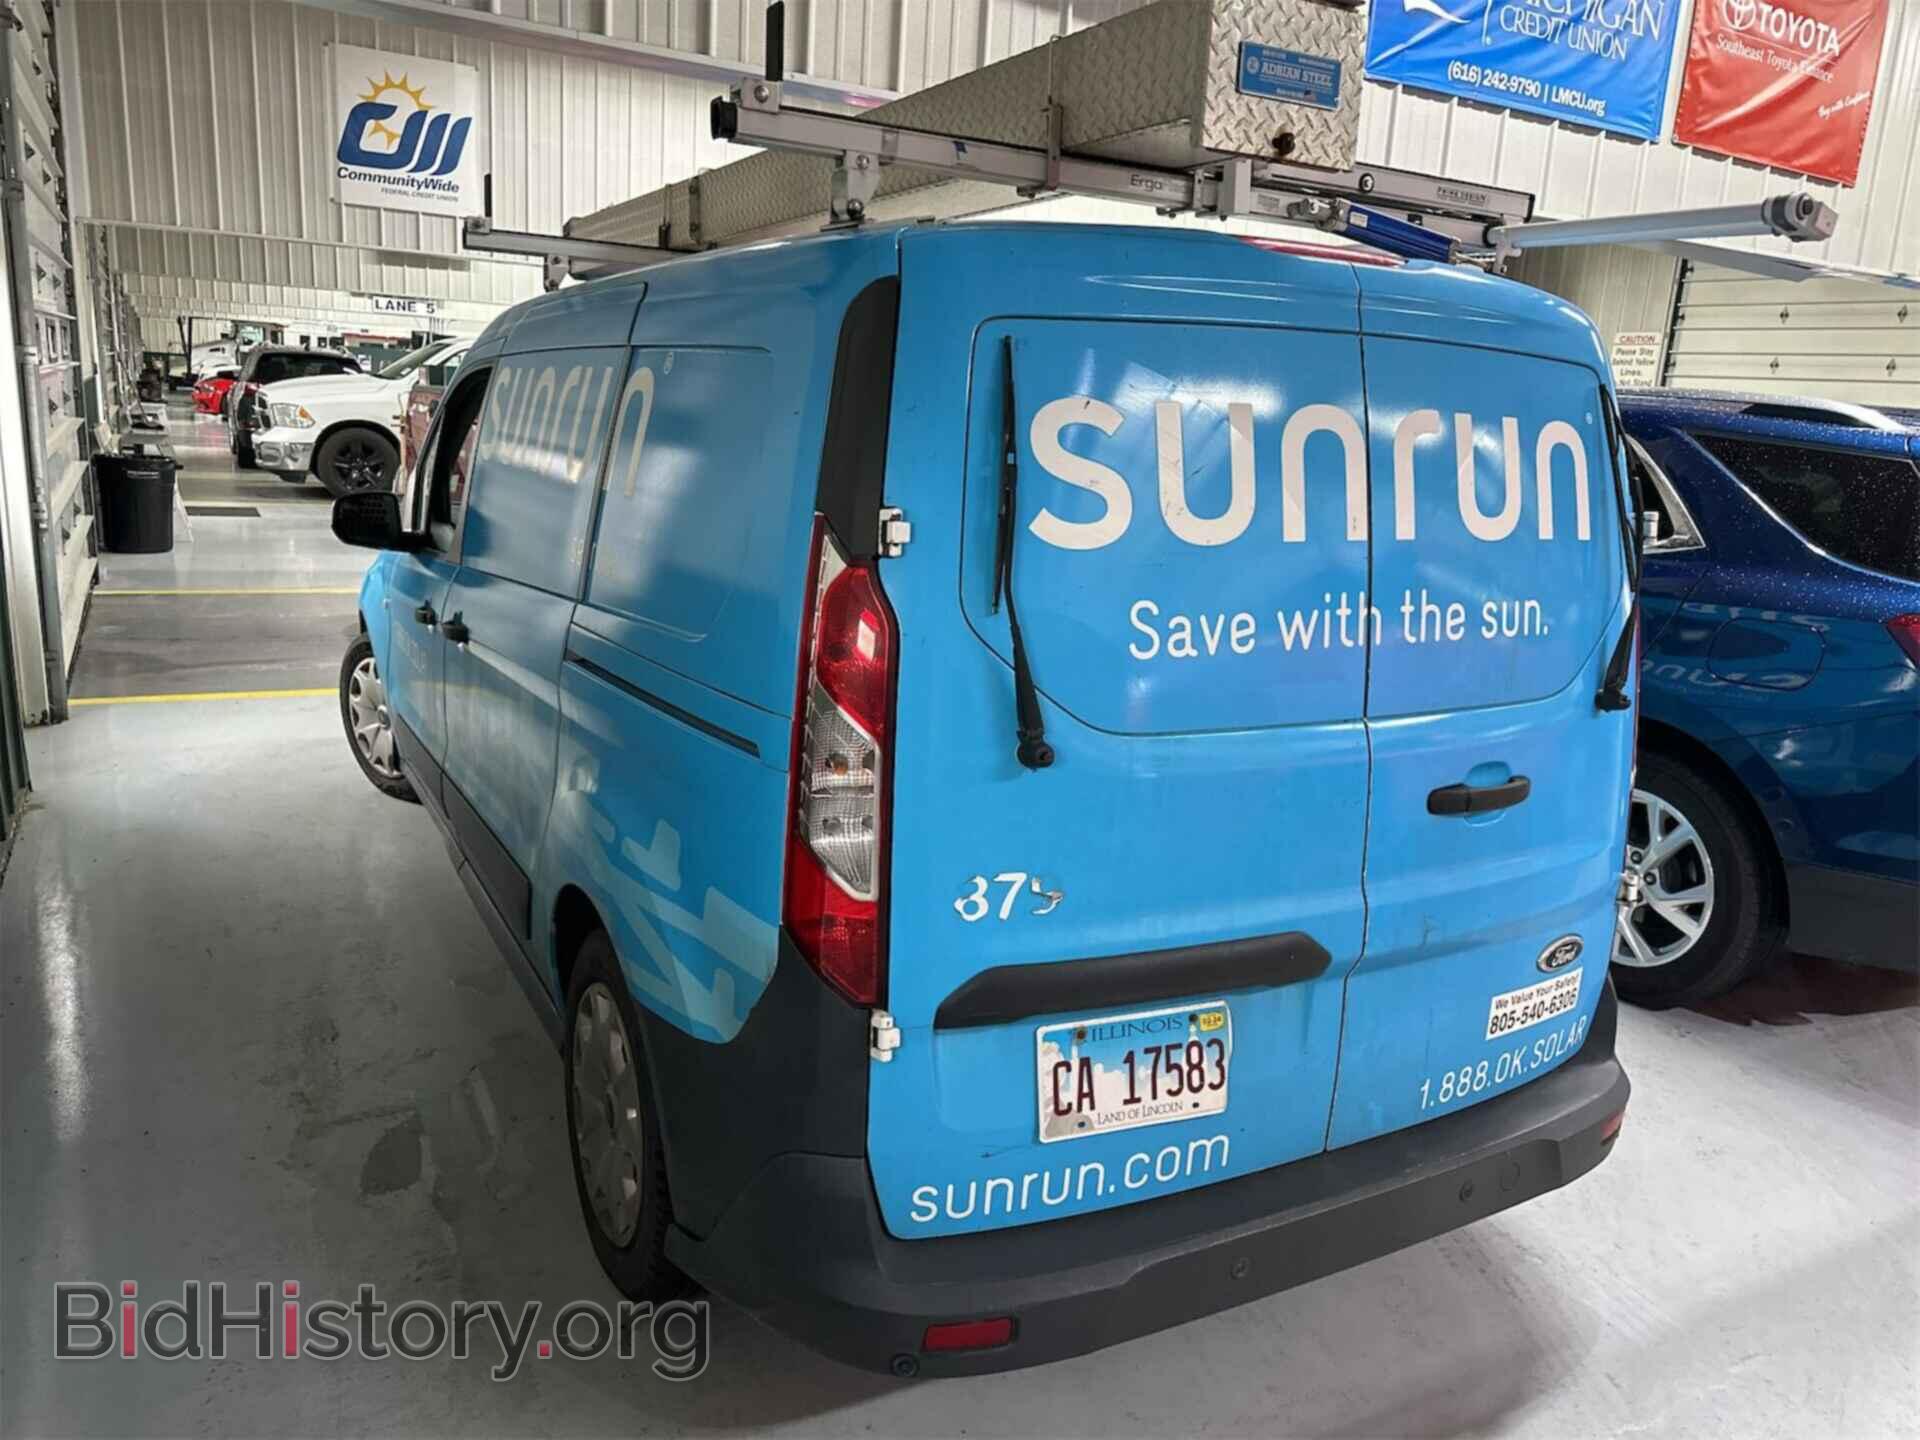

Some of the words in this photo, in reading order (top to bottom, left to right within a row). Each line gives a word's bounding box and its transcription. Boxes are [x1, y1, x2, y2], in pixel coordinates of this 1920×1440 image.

[1500, 4, 1568, 45] CREDIT
[1567, 23, 1629, 62] UNION
[1716, 32, 1764, 65] Southeast
[1757, 4, 1841, 57] TOYOTA
[1447, 60, 1482, 87] (616)
[1483, 68, 1541, 99] 242-9790
[1551, 86, 1607, 116] LMCU.org
[337, 166, 460, 194] CommunityWide
[1130, 173, 1162, 193] Ergo
[374, 298, 417, 313] LANE
[426, 302, 436, 314] 5
[1619, 334, 1656, 346] CAUTION
[480, 366, 656, 498] sunrun
[1028, 396, 1592, 551] sunrun
[1128, 599, 1257, 661] Save
[1276, 591, 1383, 652] with
[1400, 588, 1466, 645] the
[1480, 598, 1550, 640] sun.
[1495, 999, 1509, 1011] We
[1511, 991, 1535, 1006] Value
[1535, 983, 1554, 998] Your
[1092, 1015, 1184, 1042] ILLINOIS
[1052, 1055, 1096, 1117] CA
[1122, 1037, 1227, 1106] 17583
[1419, 1013, 1589, 1111] 1.888.OK.SOLAR
[1096, 1109, 1127, 1126] LAND
[1127, 1106, 1141, 1119] OF
[1141, 1100, 1184, 1119] LINCOLN
[909, 1133, 1231, 1223] sunrun.com
